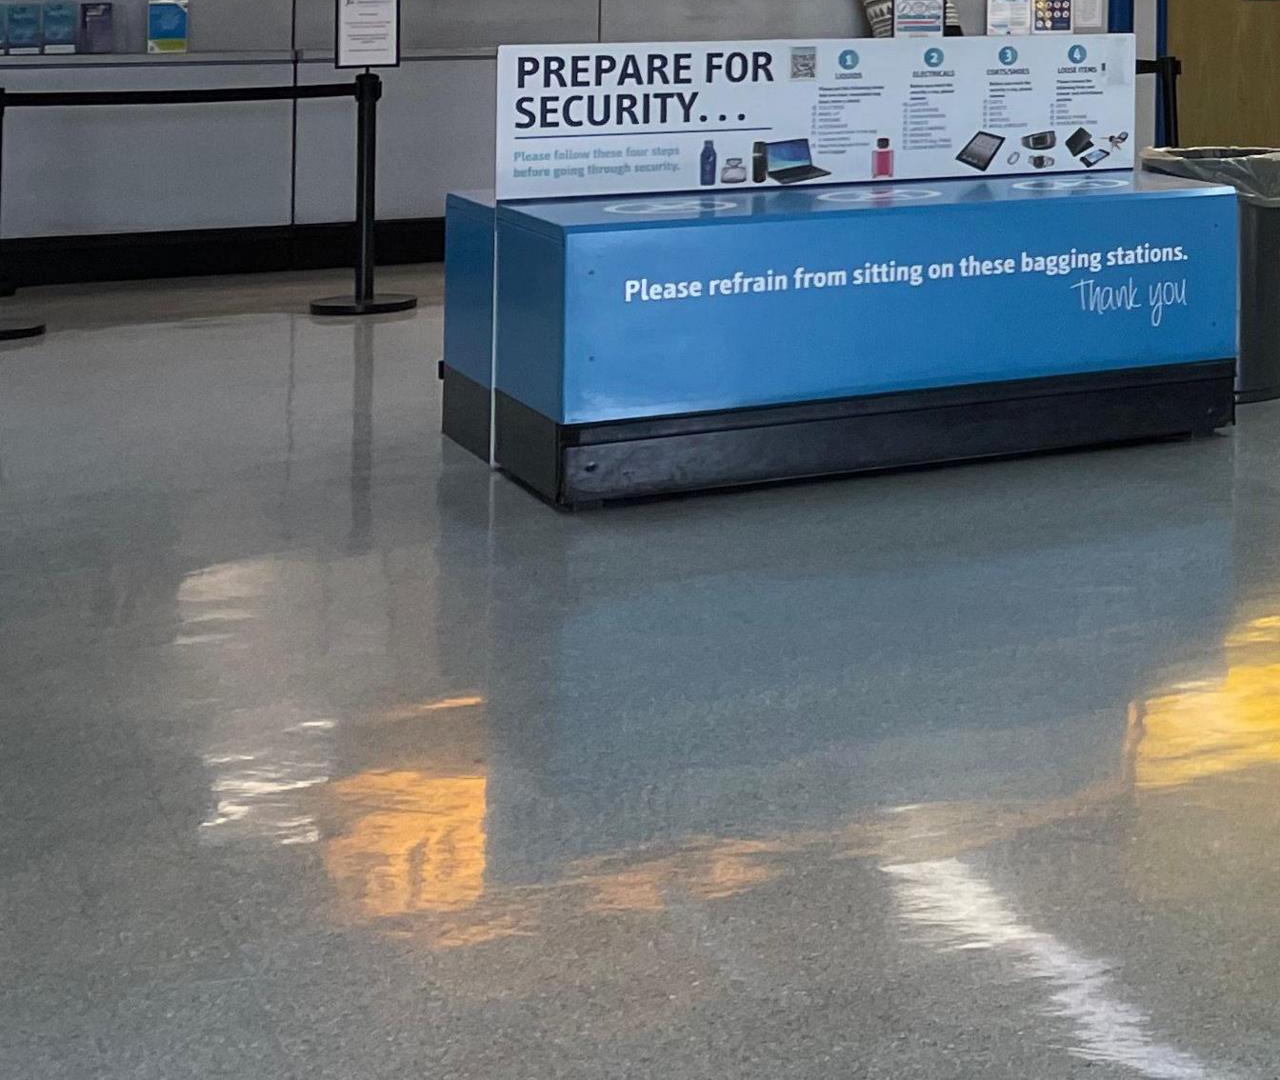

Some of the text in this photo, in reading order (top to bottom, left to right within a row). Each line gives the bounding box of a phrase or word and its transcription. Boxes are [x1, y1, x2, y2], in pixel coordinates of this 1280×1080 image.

[845, 55, 852, 65] 1
[930, 52, 938, 63] 2
[1003, 49, 1012, 62] 3
[1073, 47, 1081, 60] 4
[516, 52, 774, 88] PREPARE FOR
[514, 91, 746, 129] SECURITY...
[513, 146, 680, 162] Please follow these four steps
[513, 162, 680, 179] before going through security.
[624, 242, 1189, 302] Please refrain from sitting on these bagging stations.
[1070, 276, 1188, 327] Thank you
